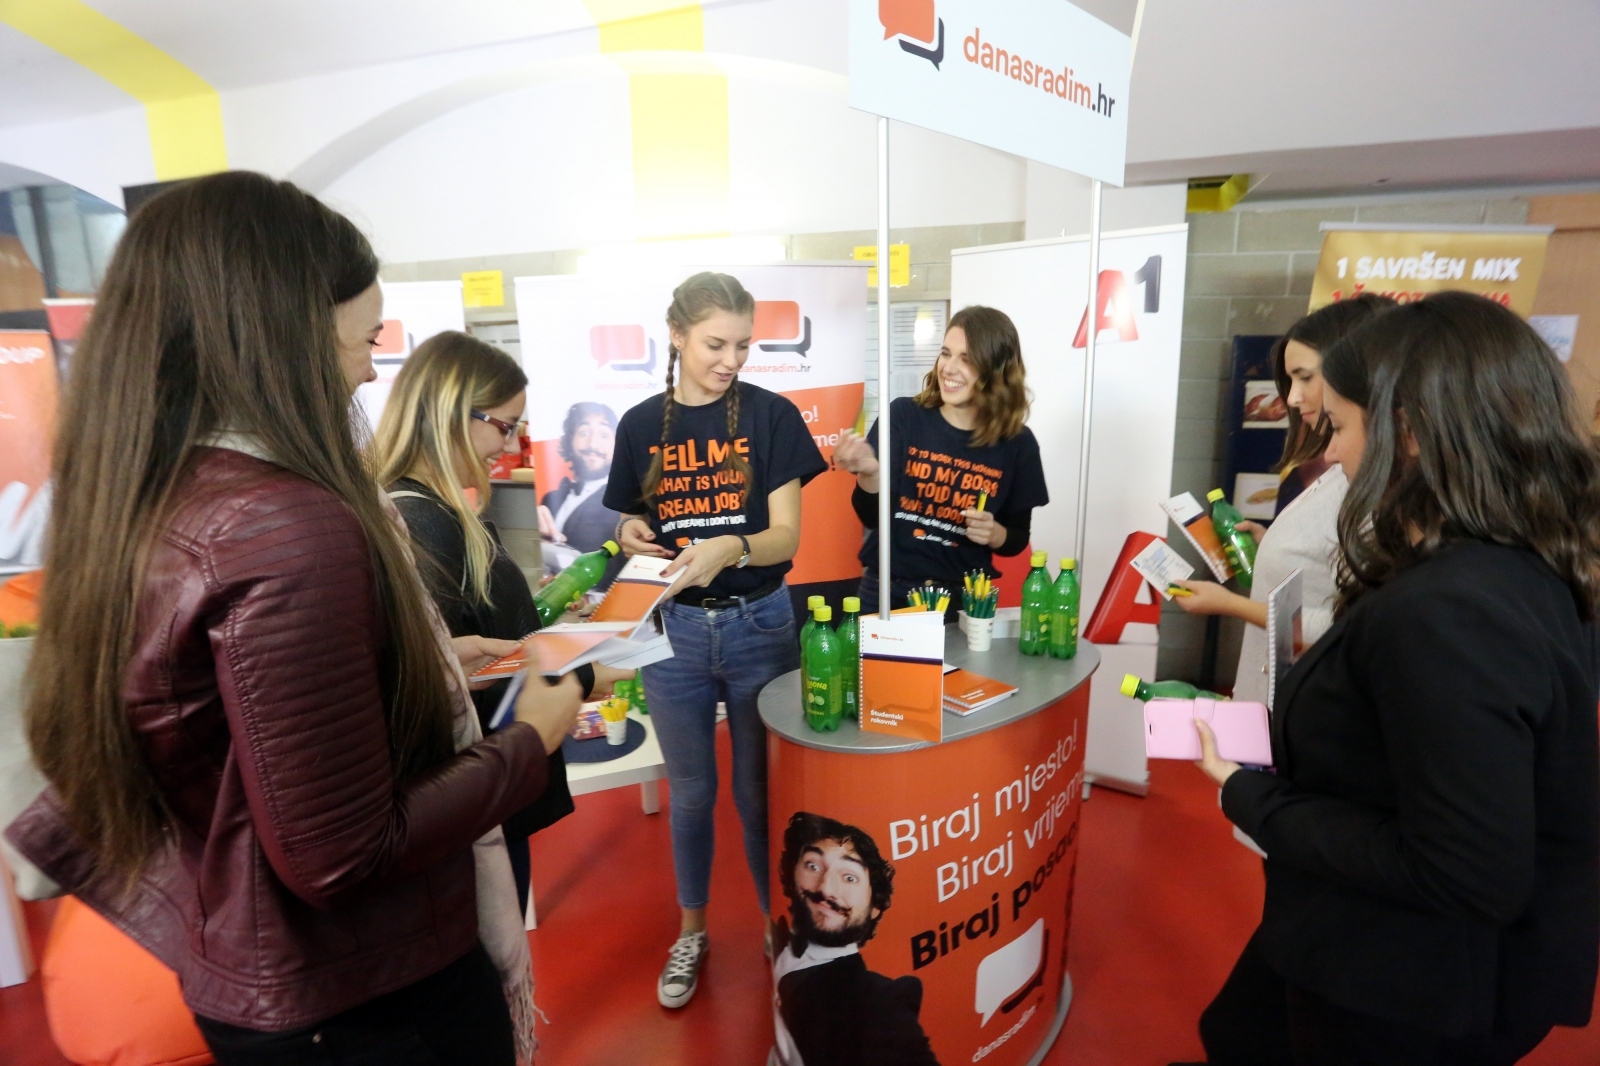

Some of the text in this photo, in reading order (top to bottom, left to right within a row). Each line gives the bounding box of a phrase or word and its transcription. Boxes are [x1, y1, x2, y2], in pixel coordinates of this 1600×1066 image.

[963, 27, 1116, 118] danasradim.hr
[1336, 251, 1522, 282] 1 SAVRŠEN MIX
[1071, 254, 1162, 349] A1
[707, 437, 750, 467] ME
[905, 460, 999, 498] AND MY BOSS
[916, 482, 951, 504] TOLD
[658, 496, 710, 520] DREAM
[924, 503, 934, 517] A
[870, 709, 904, 721] Studentski
[870, 717, 898, 727] rokovnik
[889, 718, 1078, 861] Biraj mjesto!
[936, 831, 1014, 903] Biraj
[910, 892, 1000, 971] Biraj
